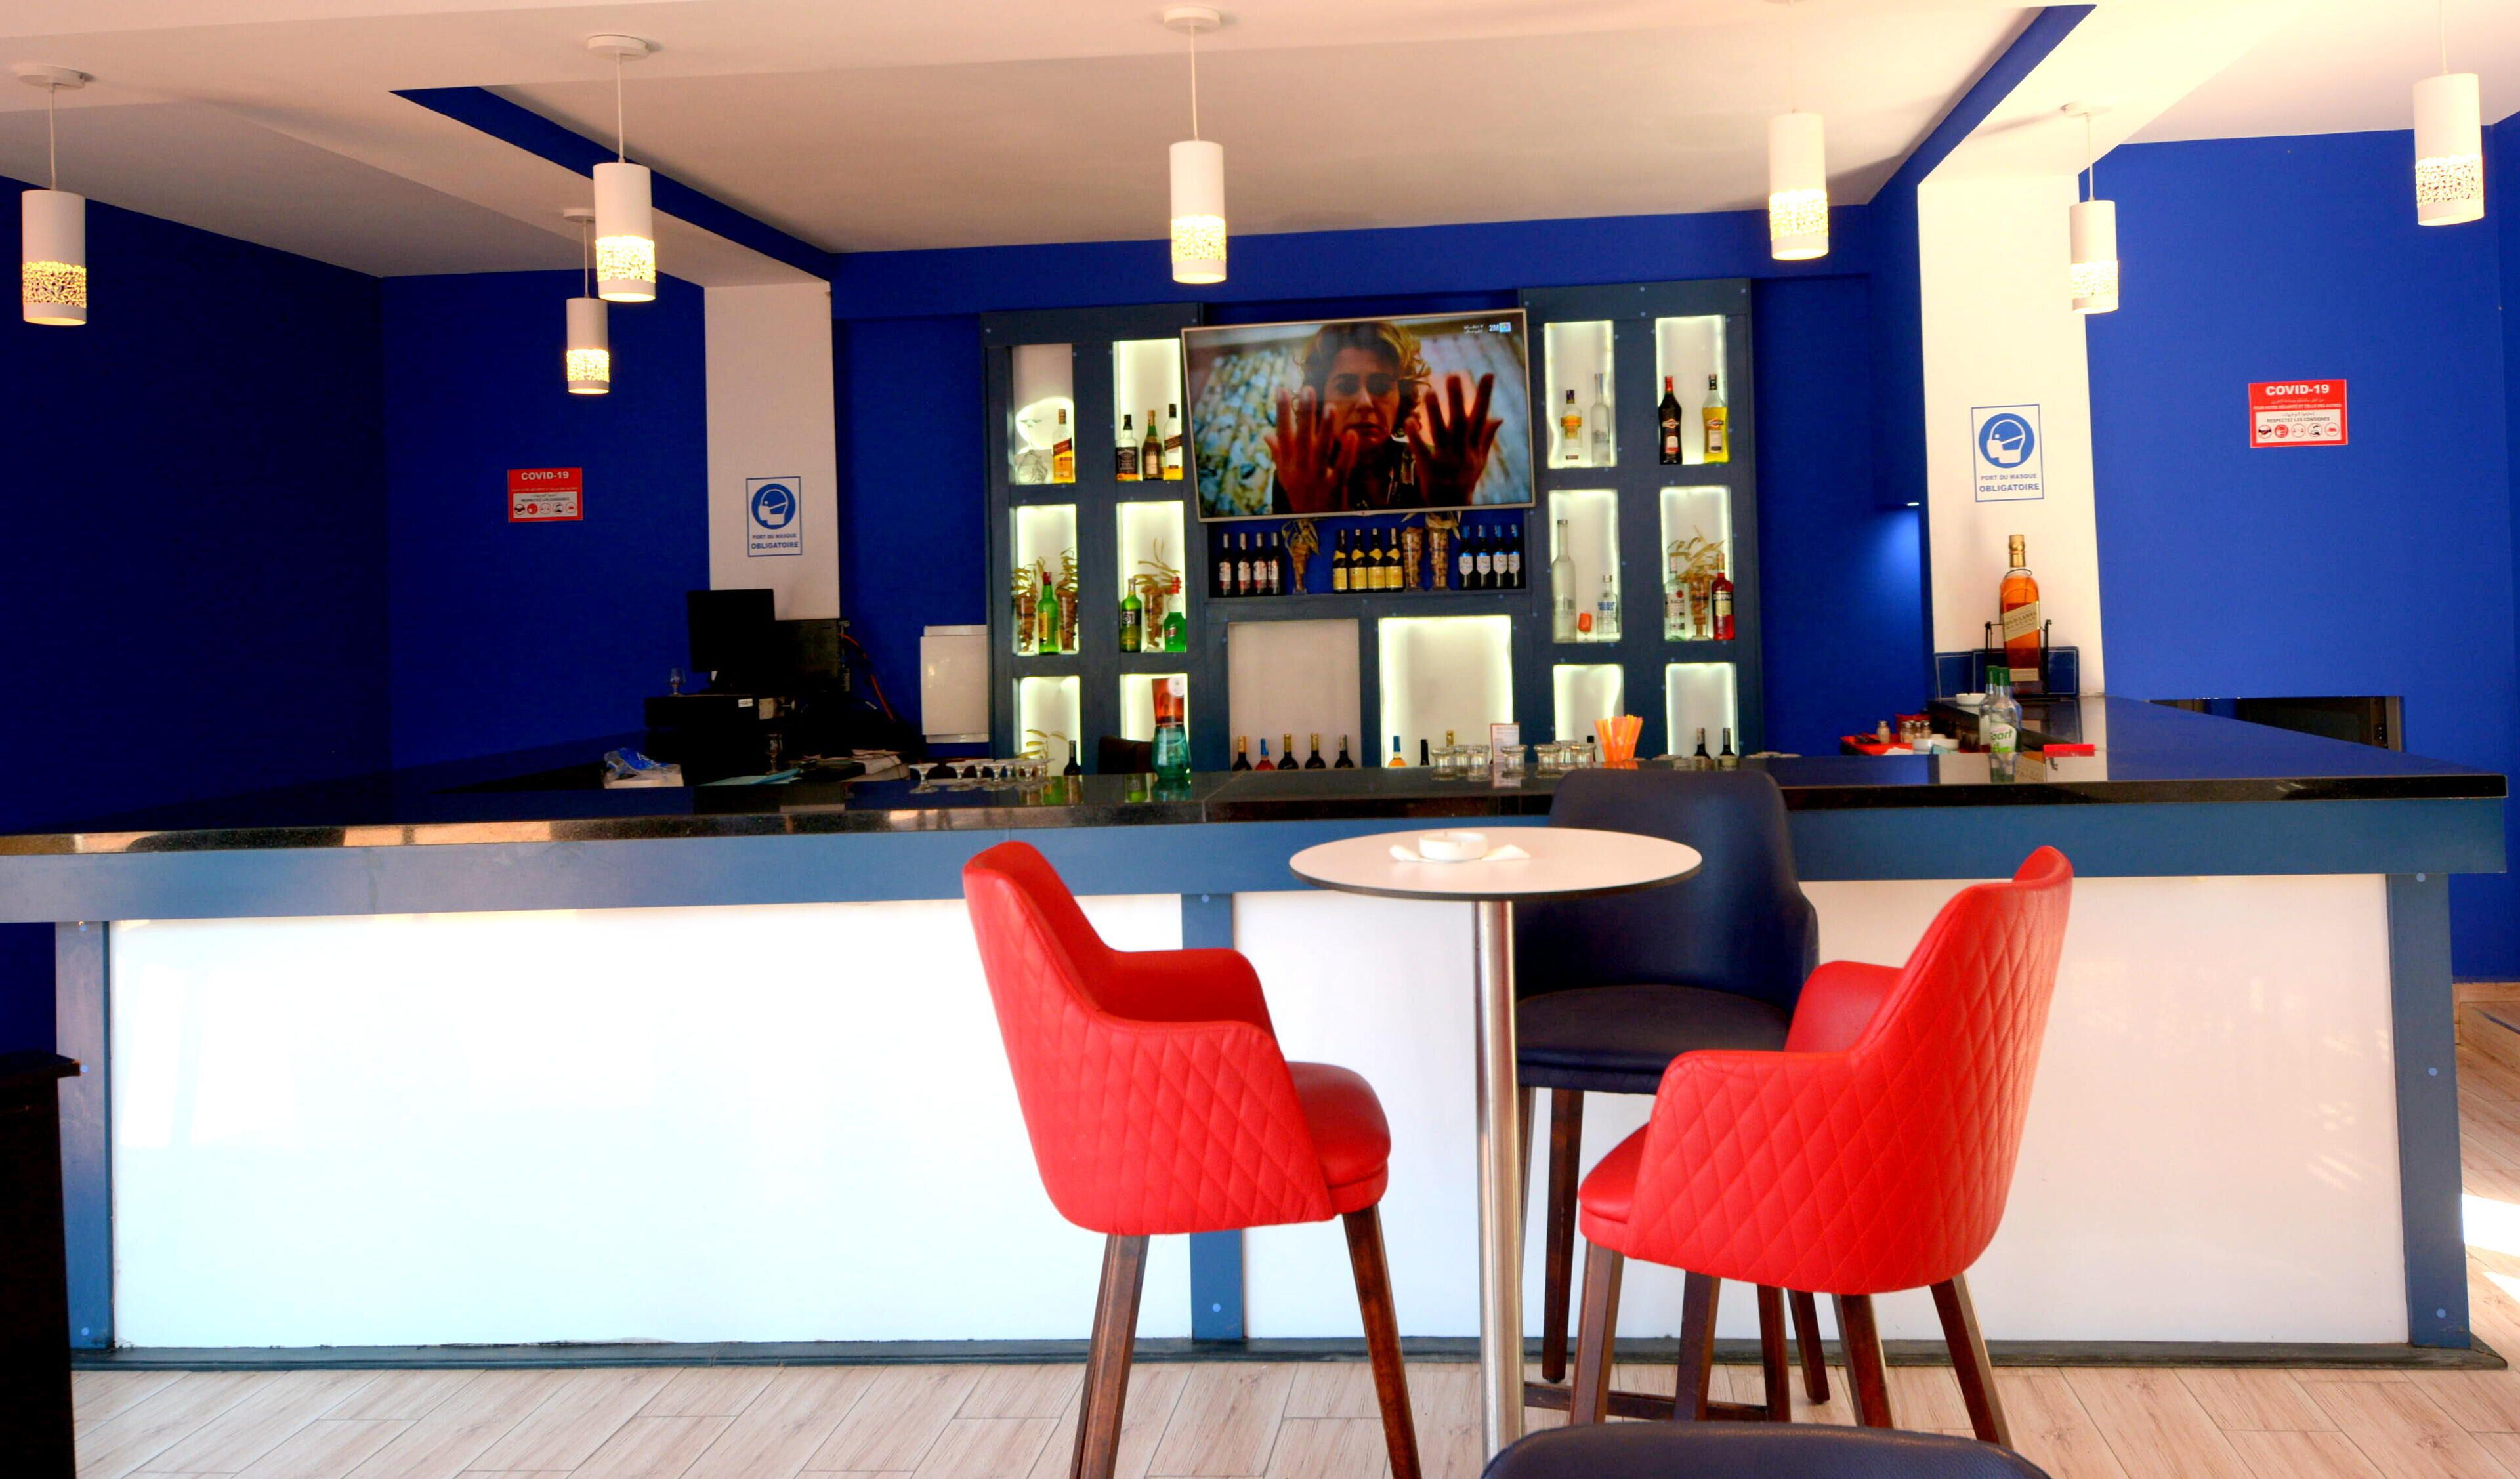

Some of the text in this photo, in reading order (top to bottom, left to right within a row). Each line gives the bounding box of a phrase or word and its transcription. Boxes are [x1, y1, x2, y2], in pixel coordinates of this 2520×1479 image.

[2265, 384, 2330, 396] COVID-19
[521, 471, 570, 480] COVID-19
[1979, 483, 2040, 493] OBLIGATOIRE
